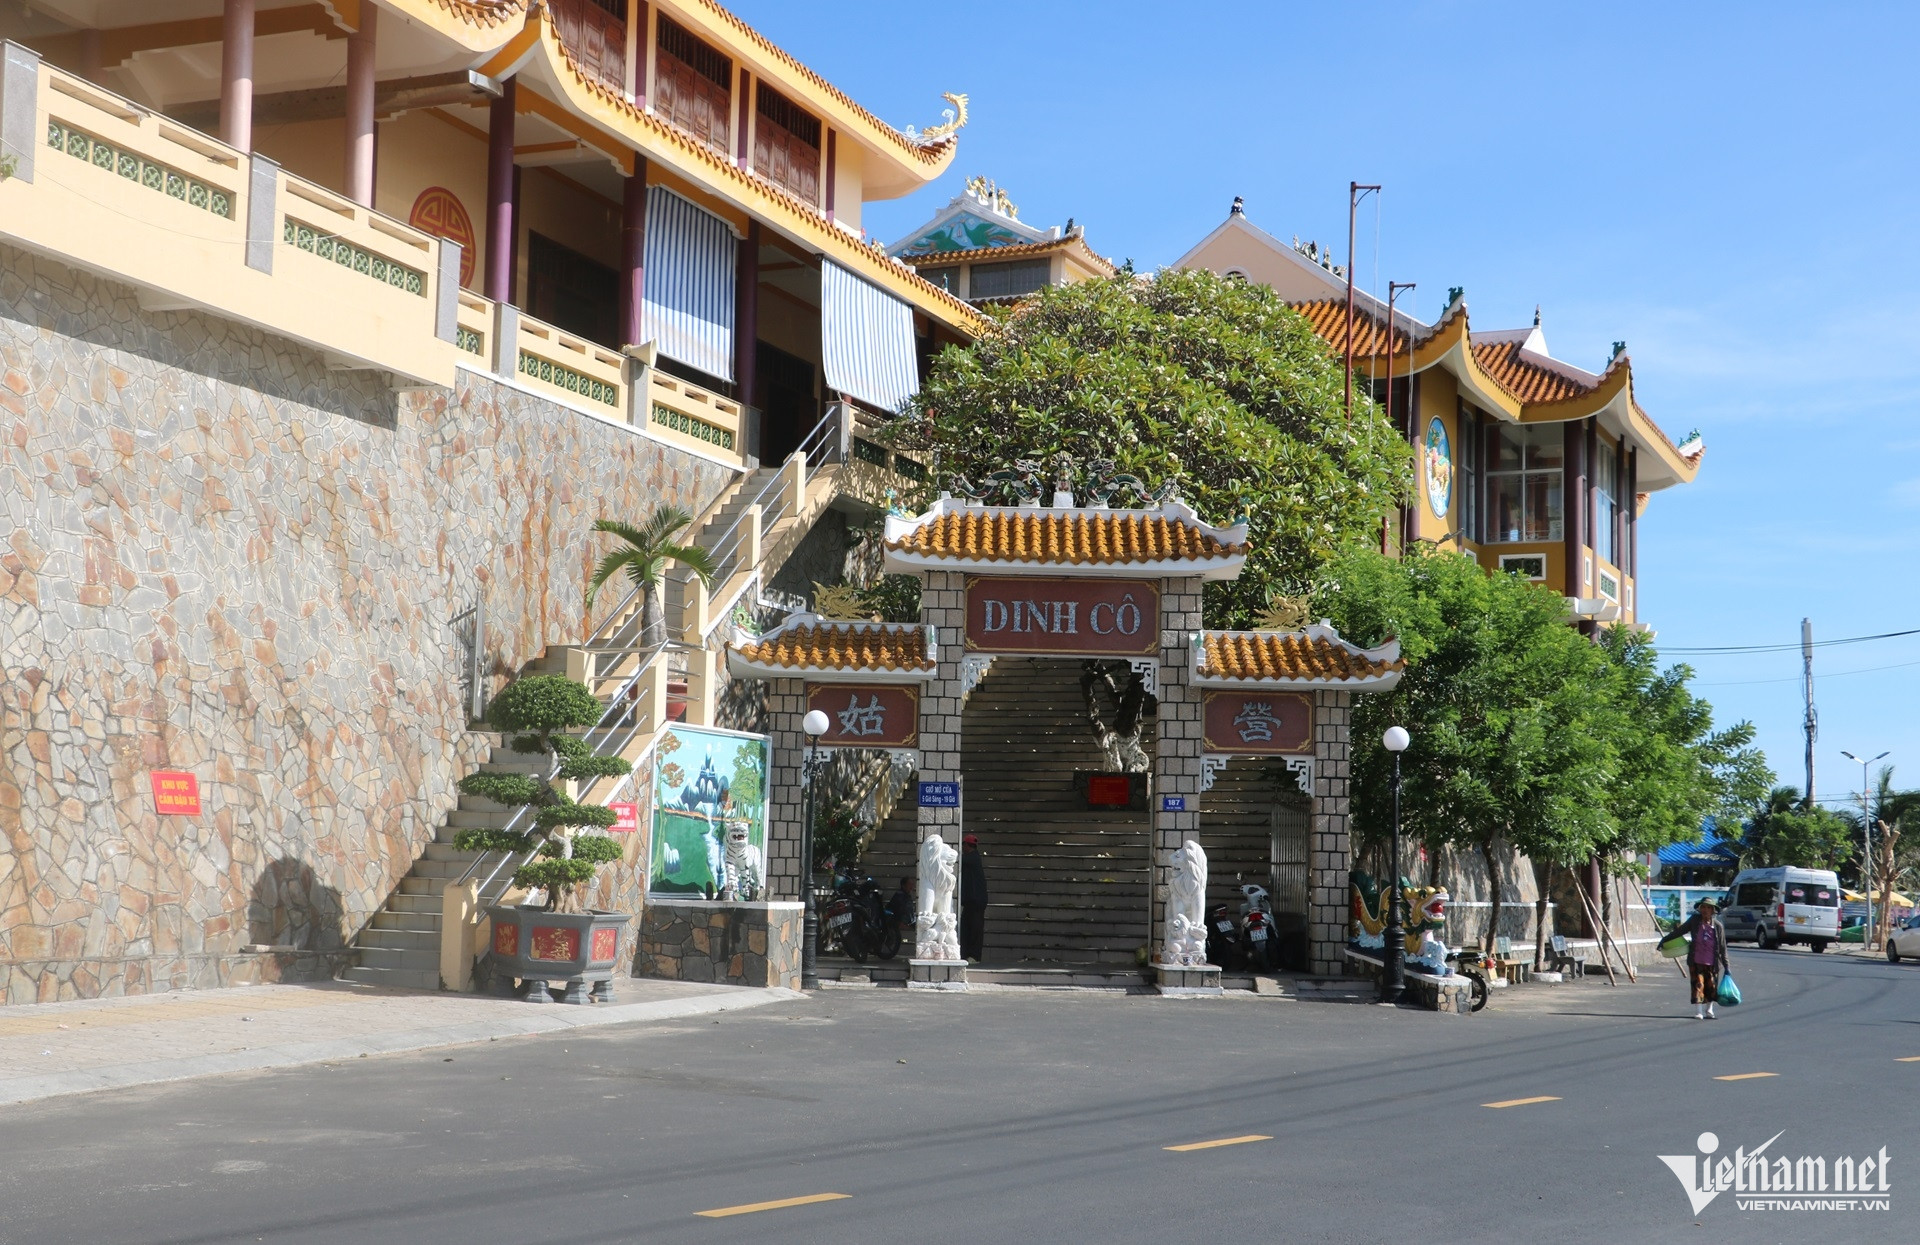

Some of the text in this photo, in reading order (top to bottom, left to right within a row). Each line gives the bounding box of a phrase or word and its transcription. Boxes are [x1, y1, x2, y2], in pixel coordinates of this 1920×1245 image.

[982, 593, 1141, 635] DINH CÔ
[836, 694, 887, 736] 姑
[161, 780, 189, 792] KHU VỰC
[925, 784, 952, 793] GIỜ MỞ CỬA
[158, 791, 174, 805] CẤM
[187, 796, 197, 806] XE
[932, 795, 941, 804] Sáng
